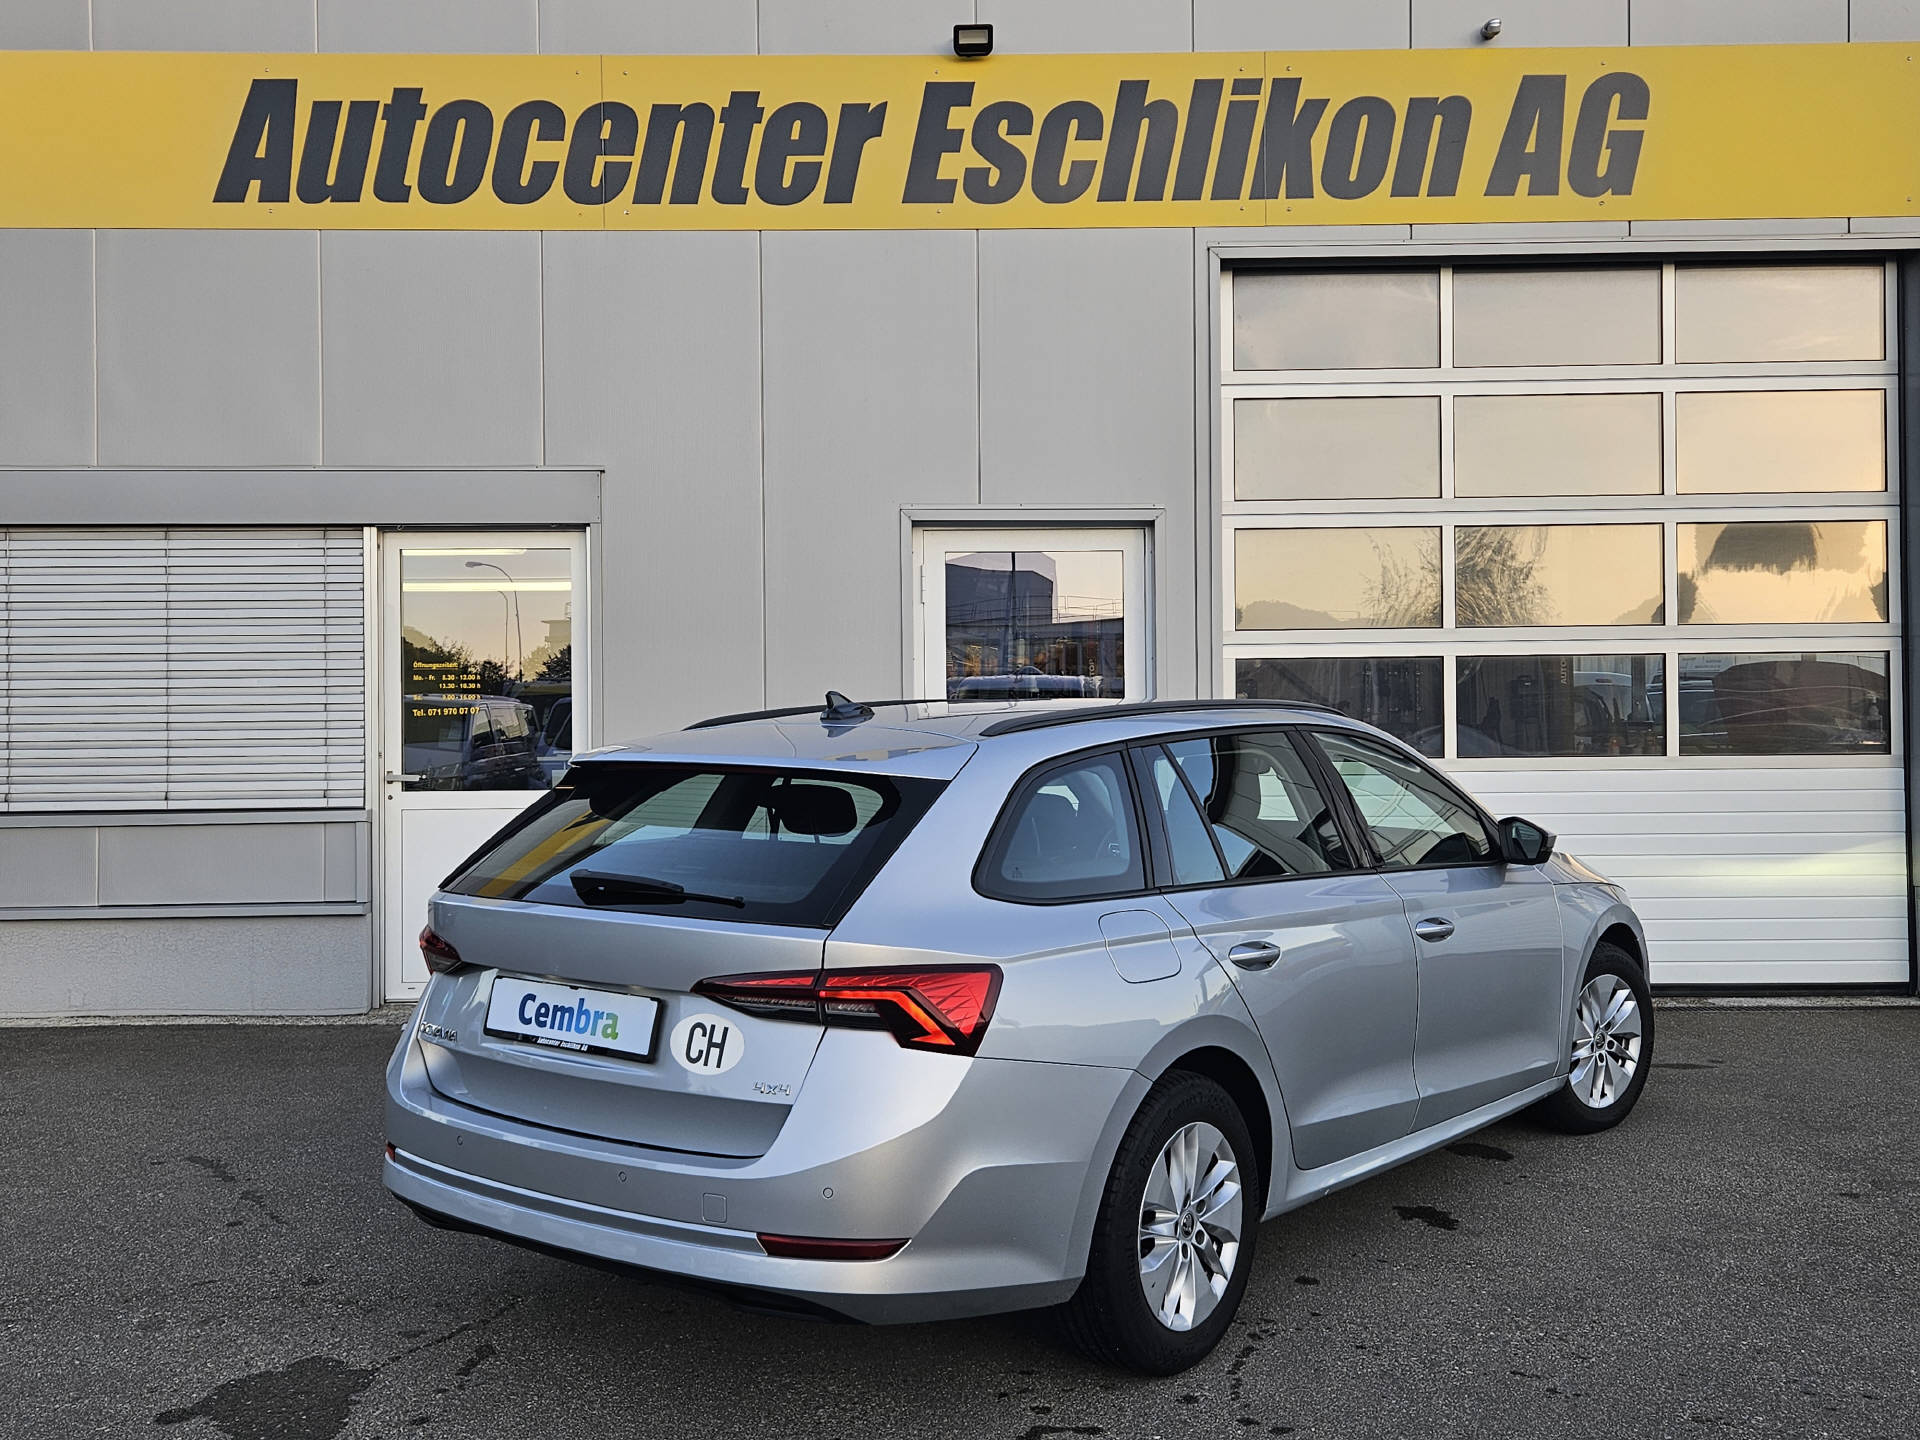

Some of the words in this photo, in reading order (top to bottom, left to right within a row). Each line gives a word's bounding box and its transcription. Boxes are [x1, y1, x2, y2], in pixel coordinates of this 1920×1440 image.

[212, 78, 887, 205] Autocenter
[902, 76, 1472, 204] Eschlikon
[1484, 72, 1650, 199] AG
[412, 709, 426, 717] Tel.
[427, 708, 441, 716] 071
[443, 707, 457, 715] 970
[459, 707, 468, 715] 07
[470, 706, 480, 714] 07
[518, 993, 619, 1040] Cembra
[685, 1022, 729, 1069] CH
